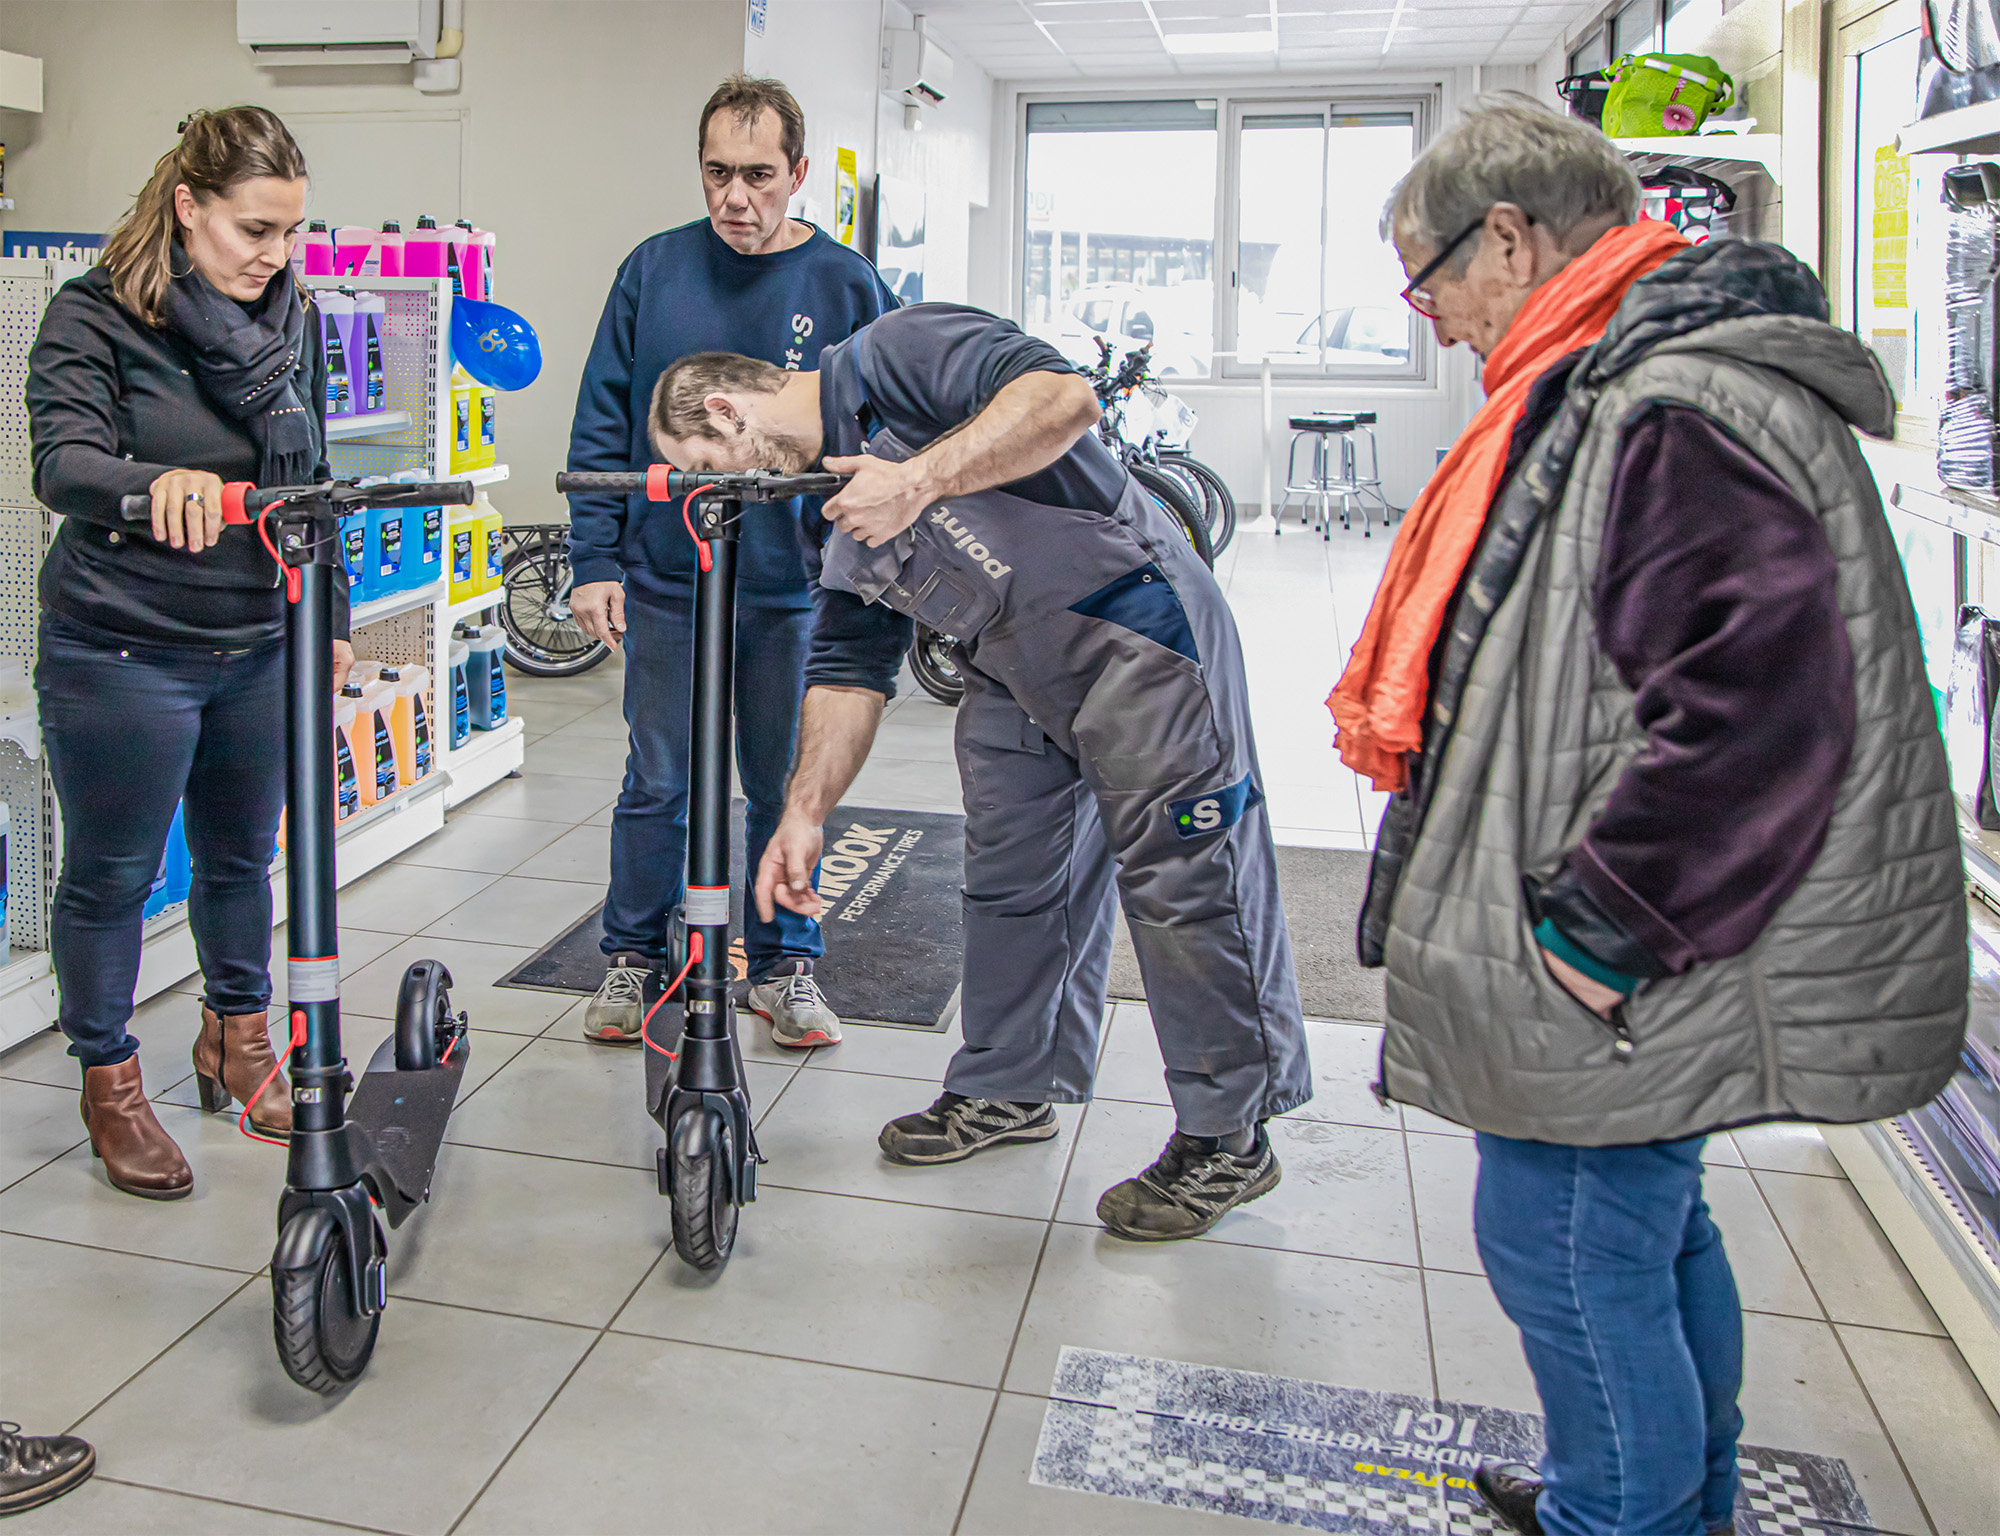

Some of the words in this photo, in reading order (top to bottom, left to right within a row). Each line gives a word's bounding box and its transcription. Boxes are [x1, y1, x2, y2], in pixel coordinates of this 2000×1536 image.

[46, 241, 107, 266] RÉVI
[930, 506, 1012, 580] point
[838, 852, 906, 922] PERFORMANCE
[892, 829, 924, 852] TIRES
[1282, 1423, 1381, 1453] VOTRE
[1393, 1408, 1478, 1447] ICI
